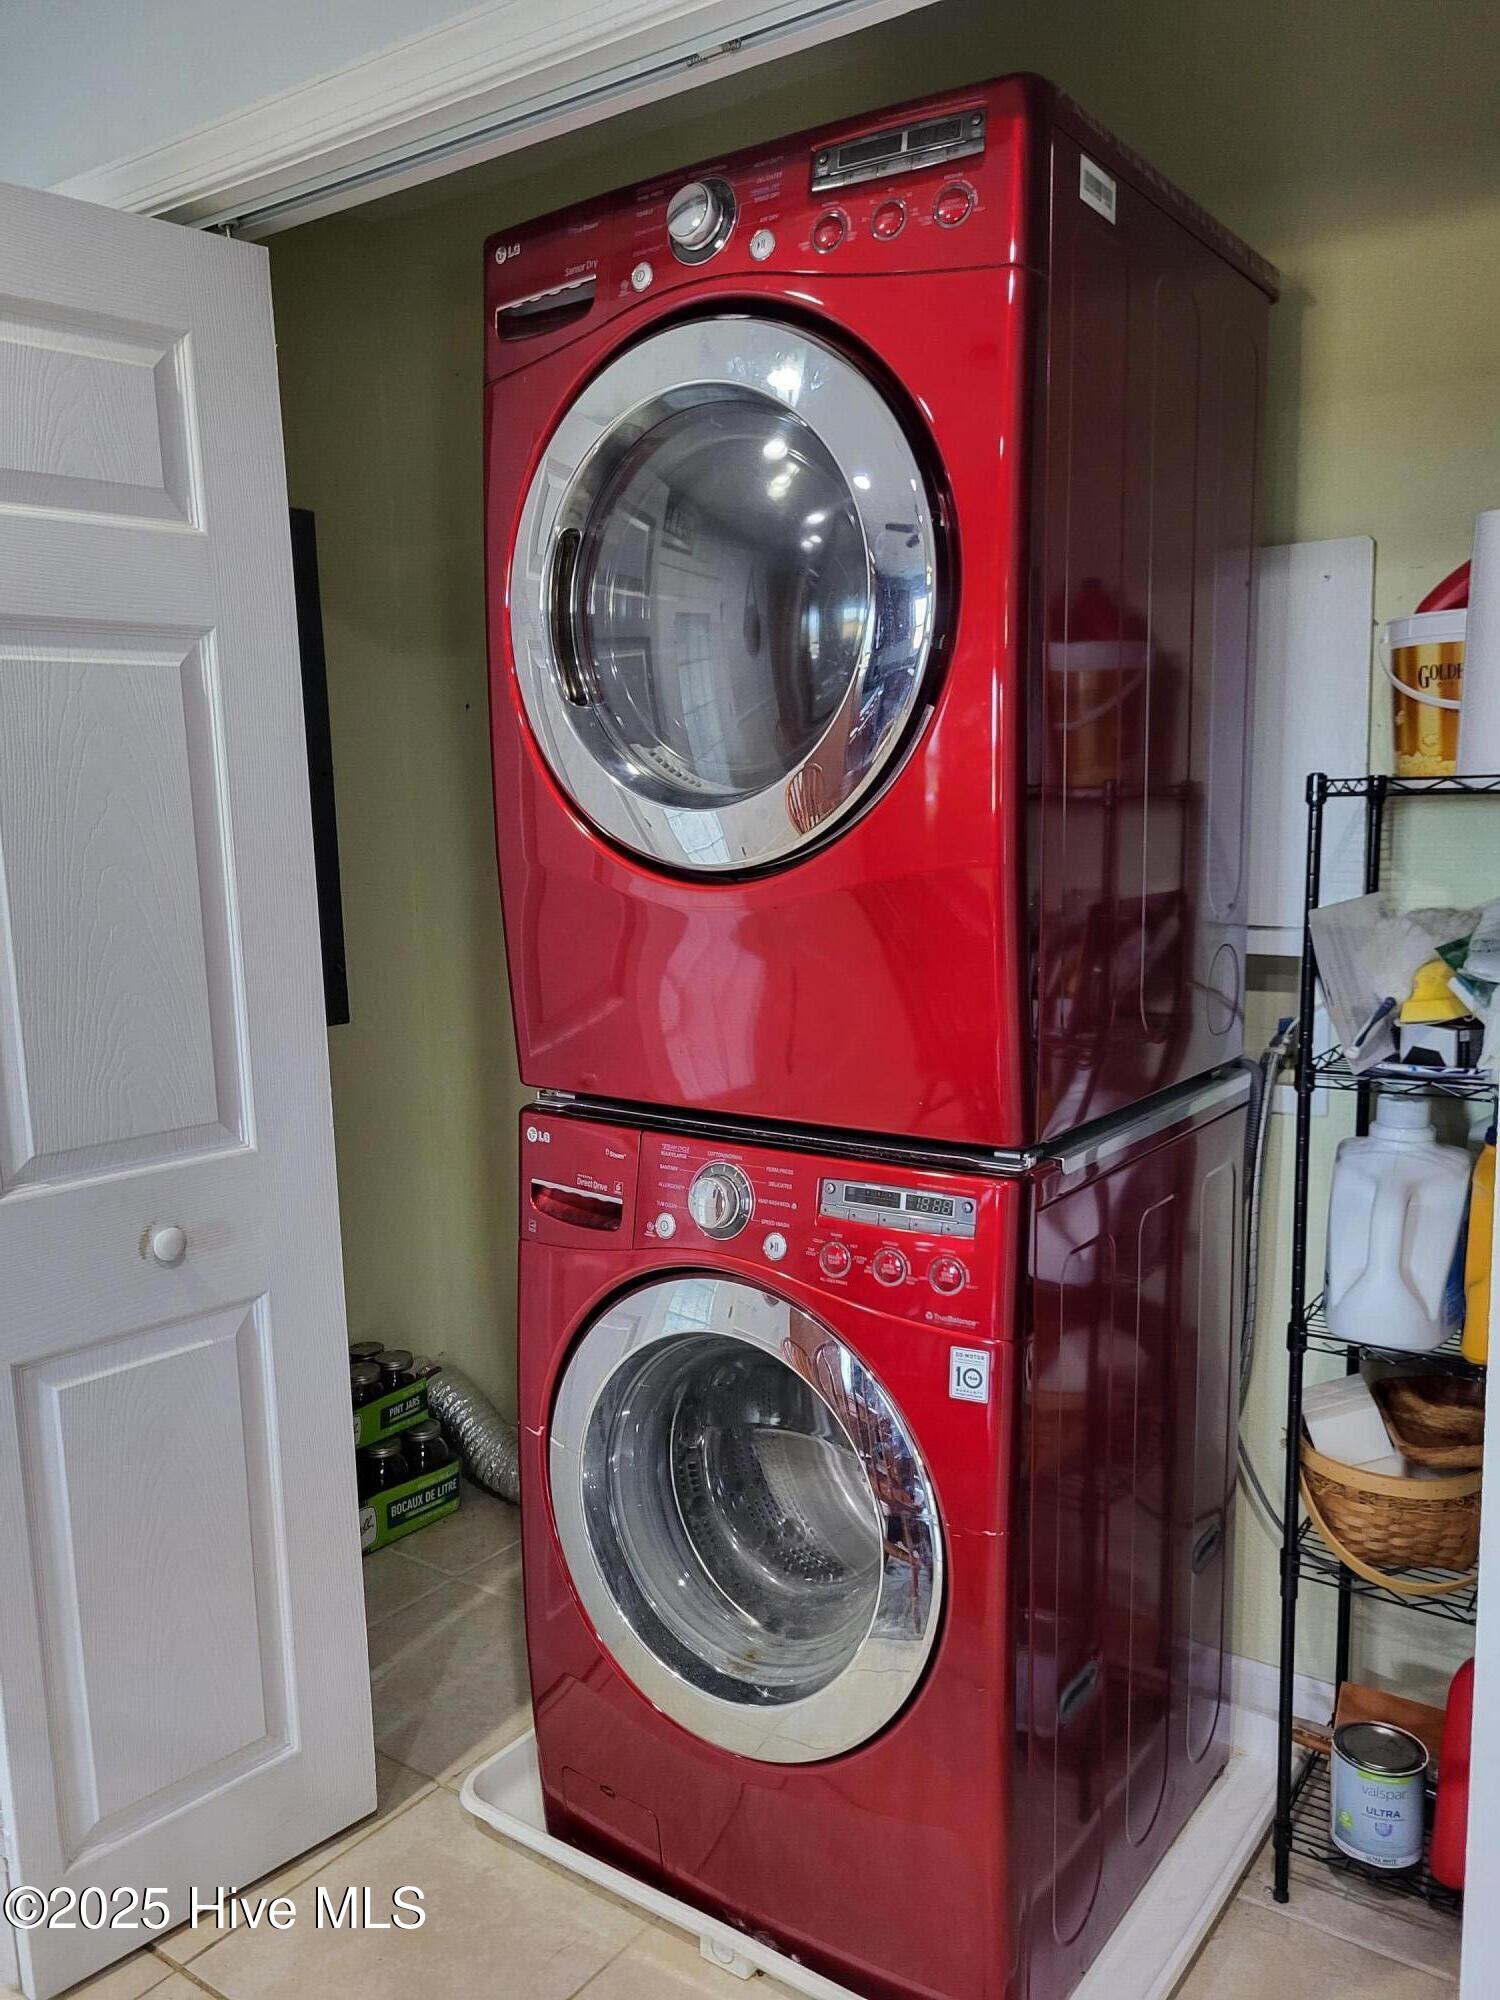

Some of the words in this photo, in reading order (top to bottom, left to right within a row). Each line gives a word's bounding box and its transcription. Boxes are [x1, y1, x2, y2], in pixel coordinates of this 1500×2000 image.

[507, 243, 520, 258] LG
[565, 263, 586, 276] Sensor
[586, 259, 598, 271] Dry
[538, 1131, 550, 1143] LG
[577, 1177, 593, 1188] Direct
[593, 1180, 608, 1192] Drive
[956, 1366, 983, 1389] 10
[389, 1404, 403, 1417] PINT
[405, 1397, 420, 1411] JARS
[391, 1495, 423, 1518] BOCAUX
[425, 1489, 435, 1502] DE
[437, 1478, 457, 1498] LITRE
[1361, 1784, 1408, 1801] valspar
[1366, 1805, 1401, 1818] ULTRA
